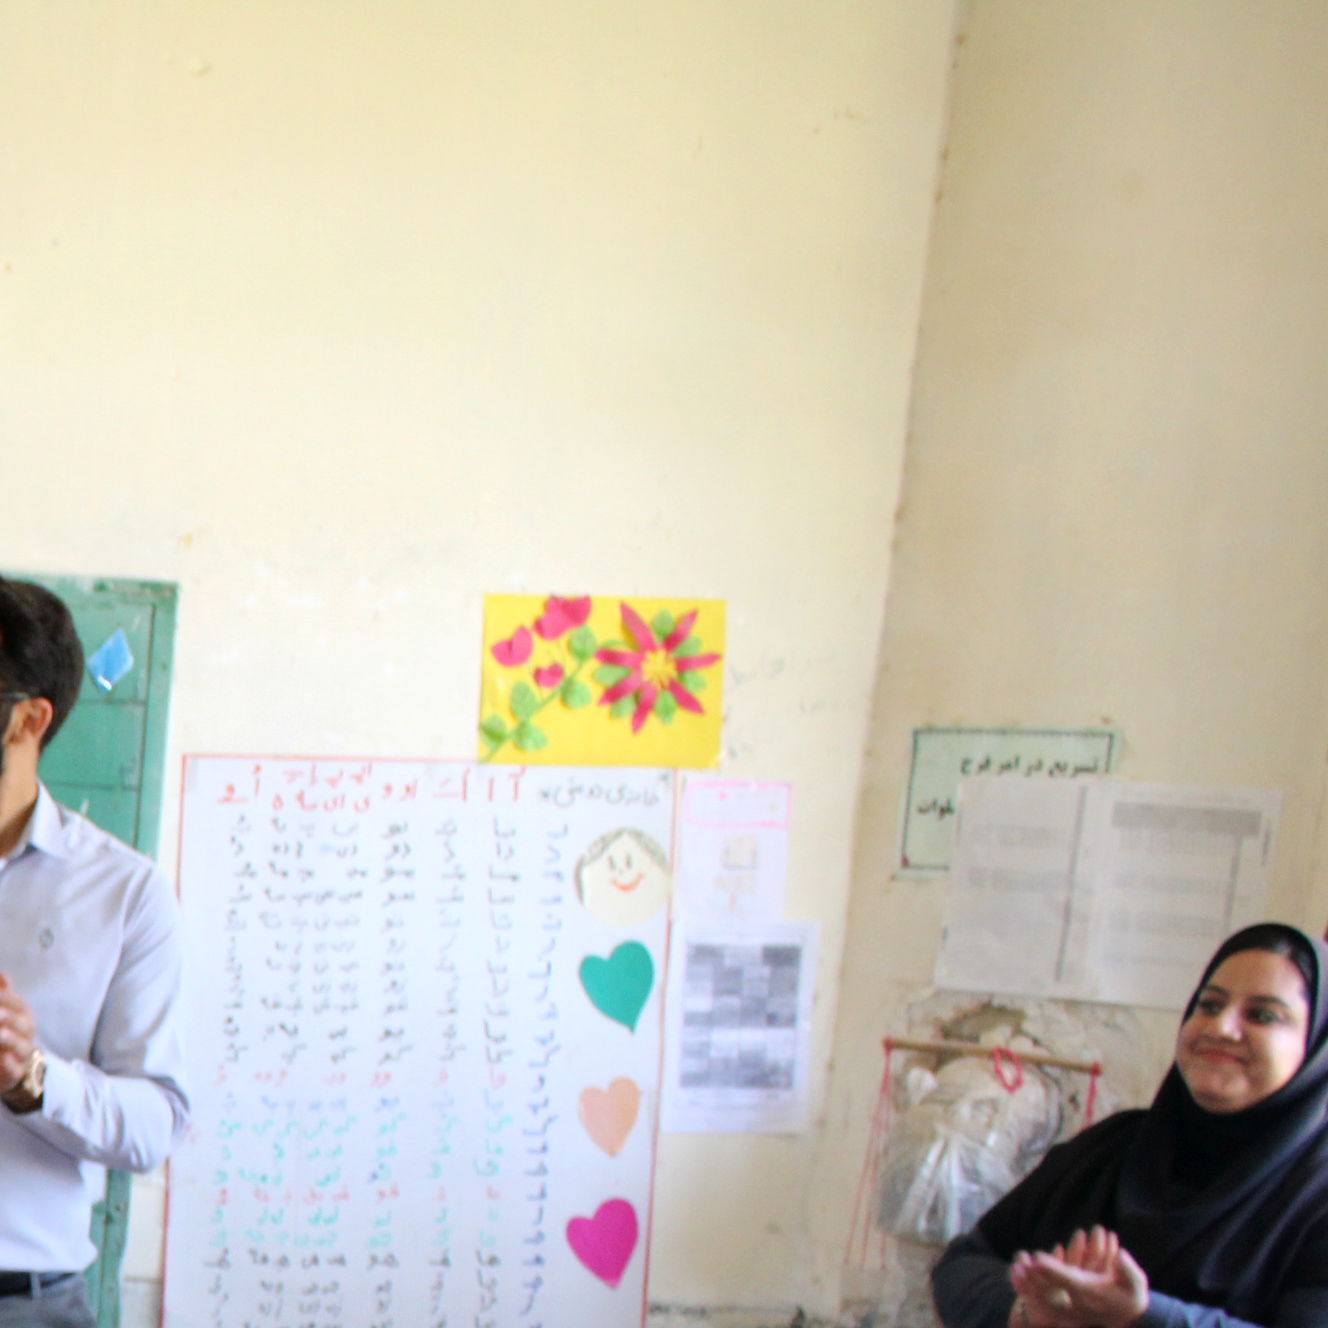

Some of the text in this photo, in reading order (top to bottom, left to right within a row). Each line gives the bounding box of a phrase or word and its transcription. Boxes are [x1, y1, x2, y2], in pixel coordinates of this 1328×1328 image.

[959, 753, 992, 776] فرج
[997, 754, 1021, 776] امر
[1025, 757, 1044, 777] در
